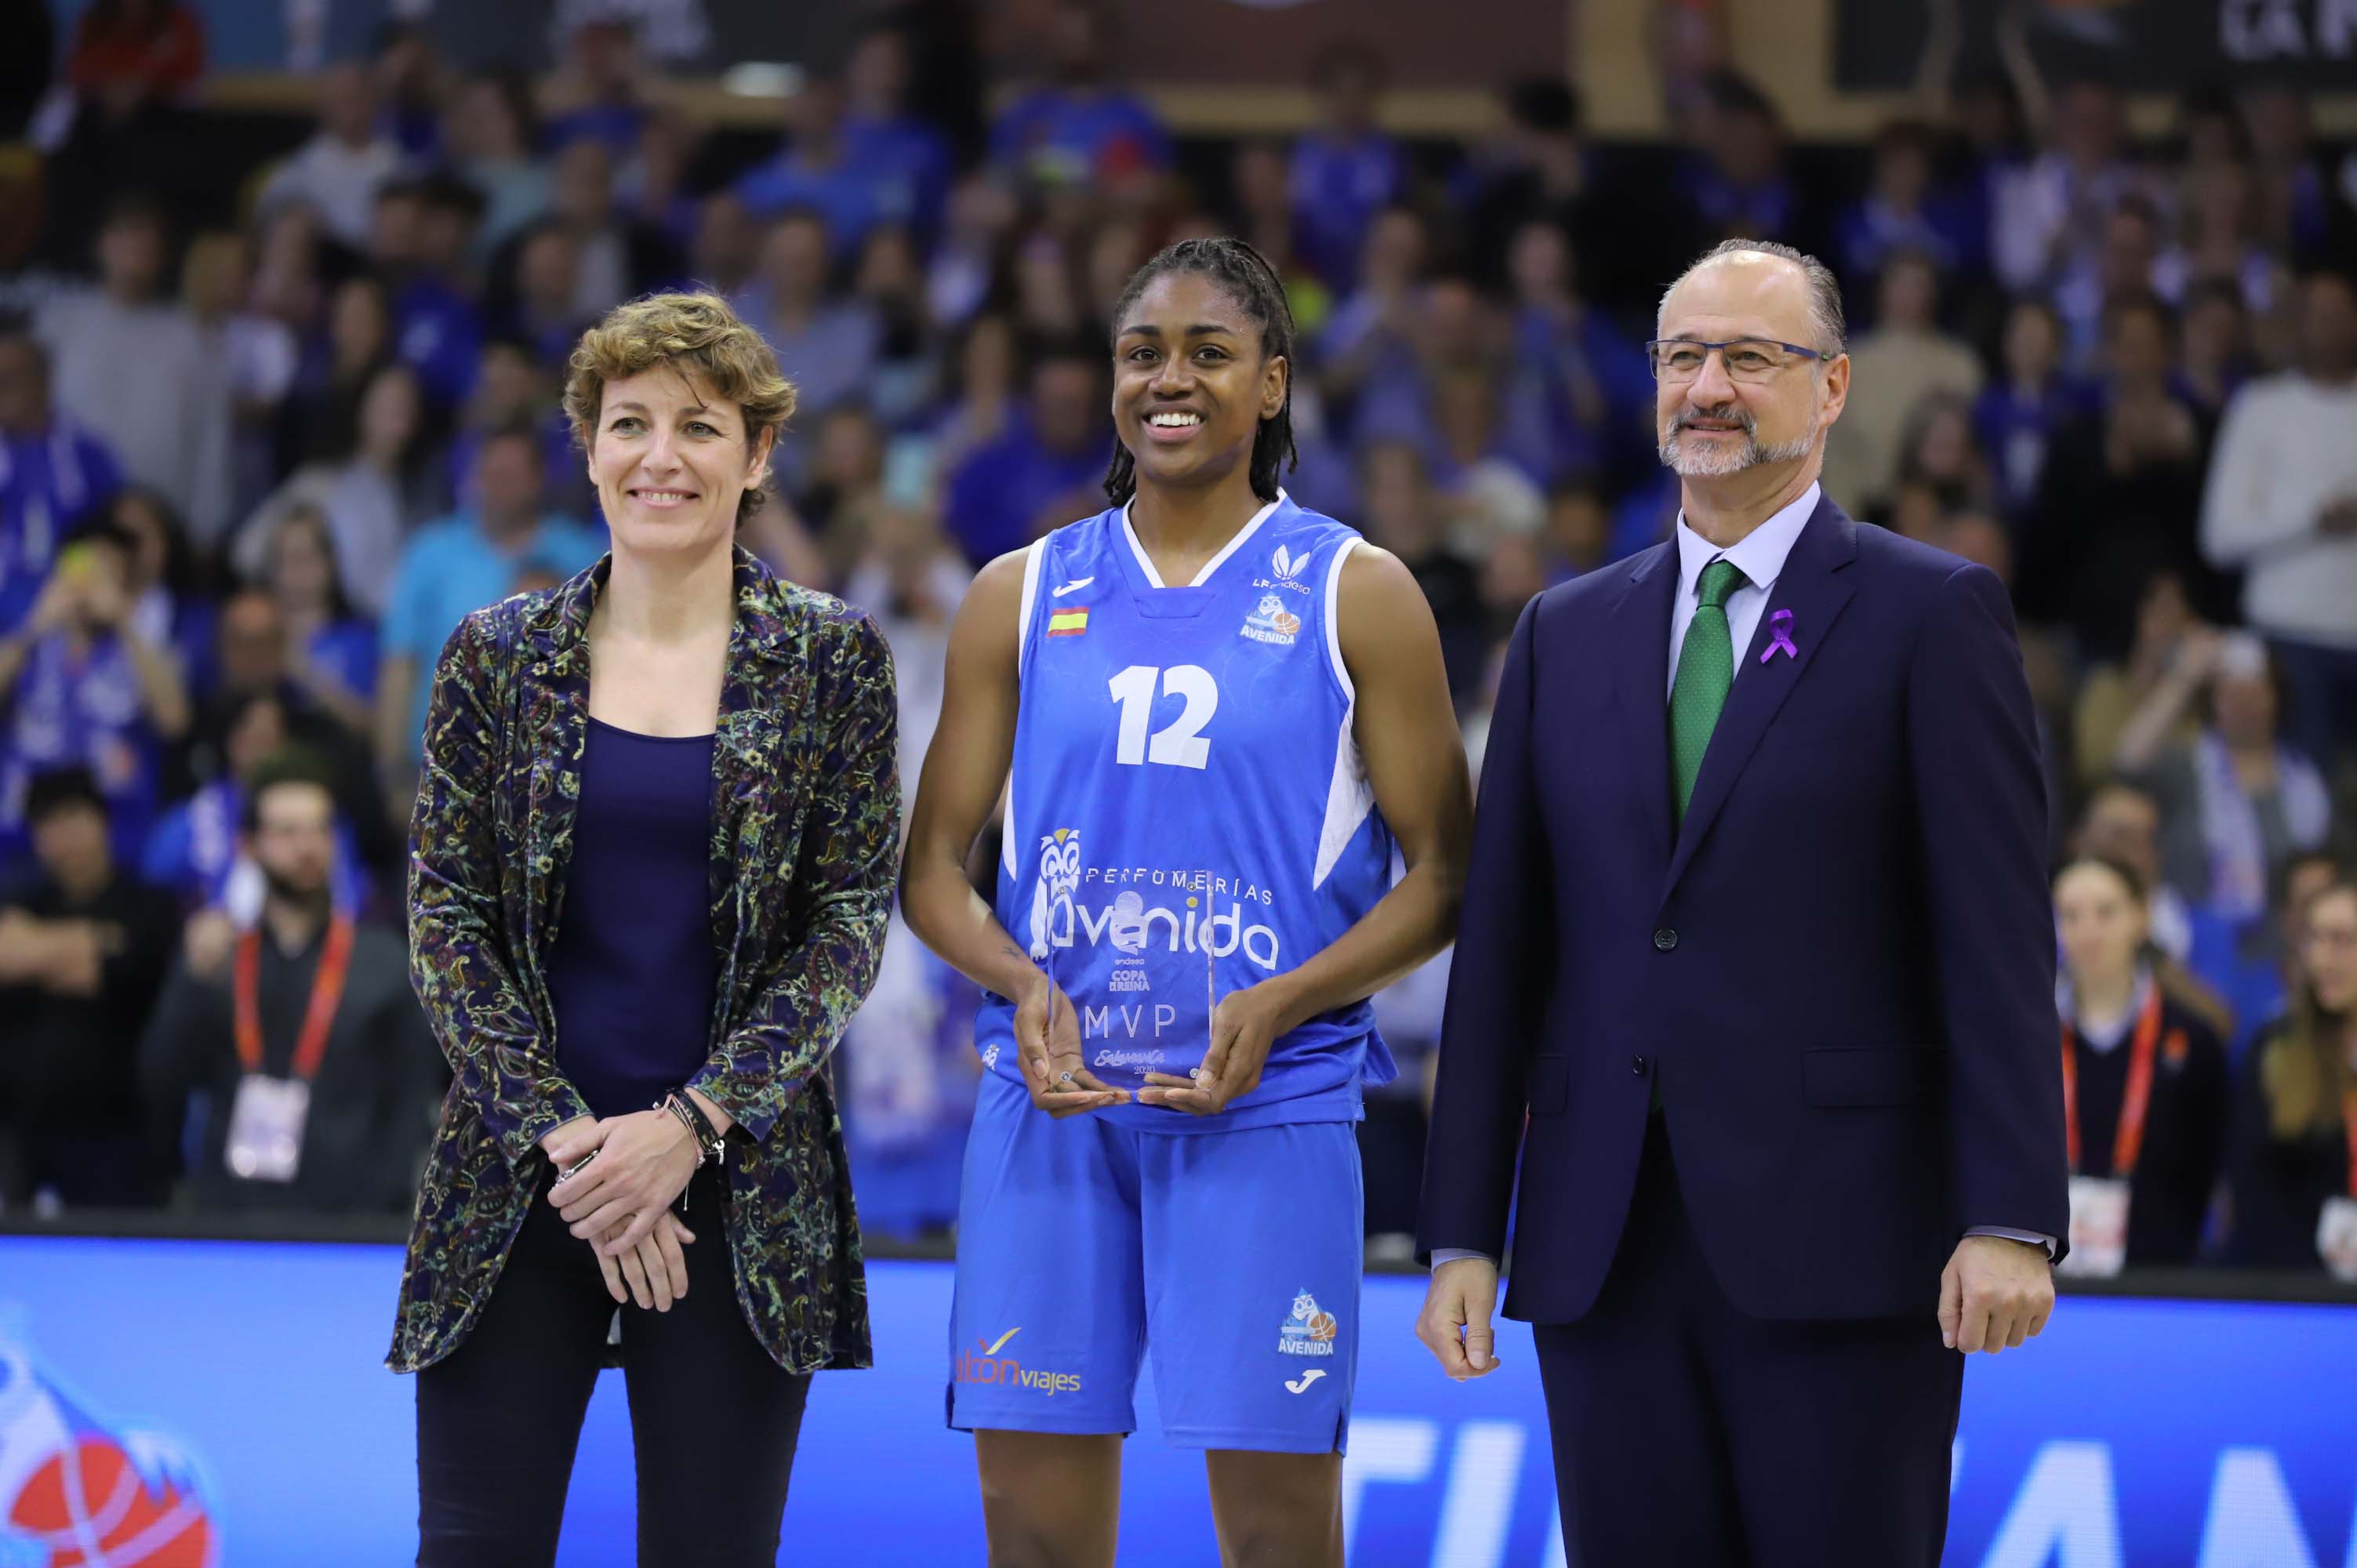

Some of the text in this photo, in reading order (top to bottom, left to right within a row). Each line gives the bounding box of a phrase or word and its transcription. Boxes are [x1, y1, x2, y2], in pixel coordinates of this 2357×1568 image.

[1240, 625, 1295, 644] AVENIDA
[1108, 664, 1218, 771] 12
[1111, 970, 1148, 982] COPA
[1084, 1004, 1175, 1039] MVP
[1278, 1338, 1334, 1356] AVENIDA
